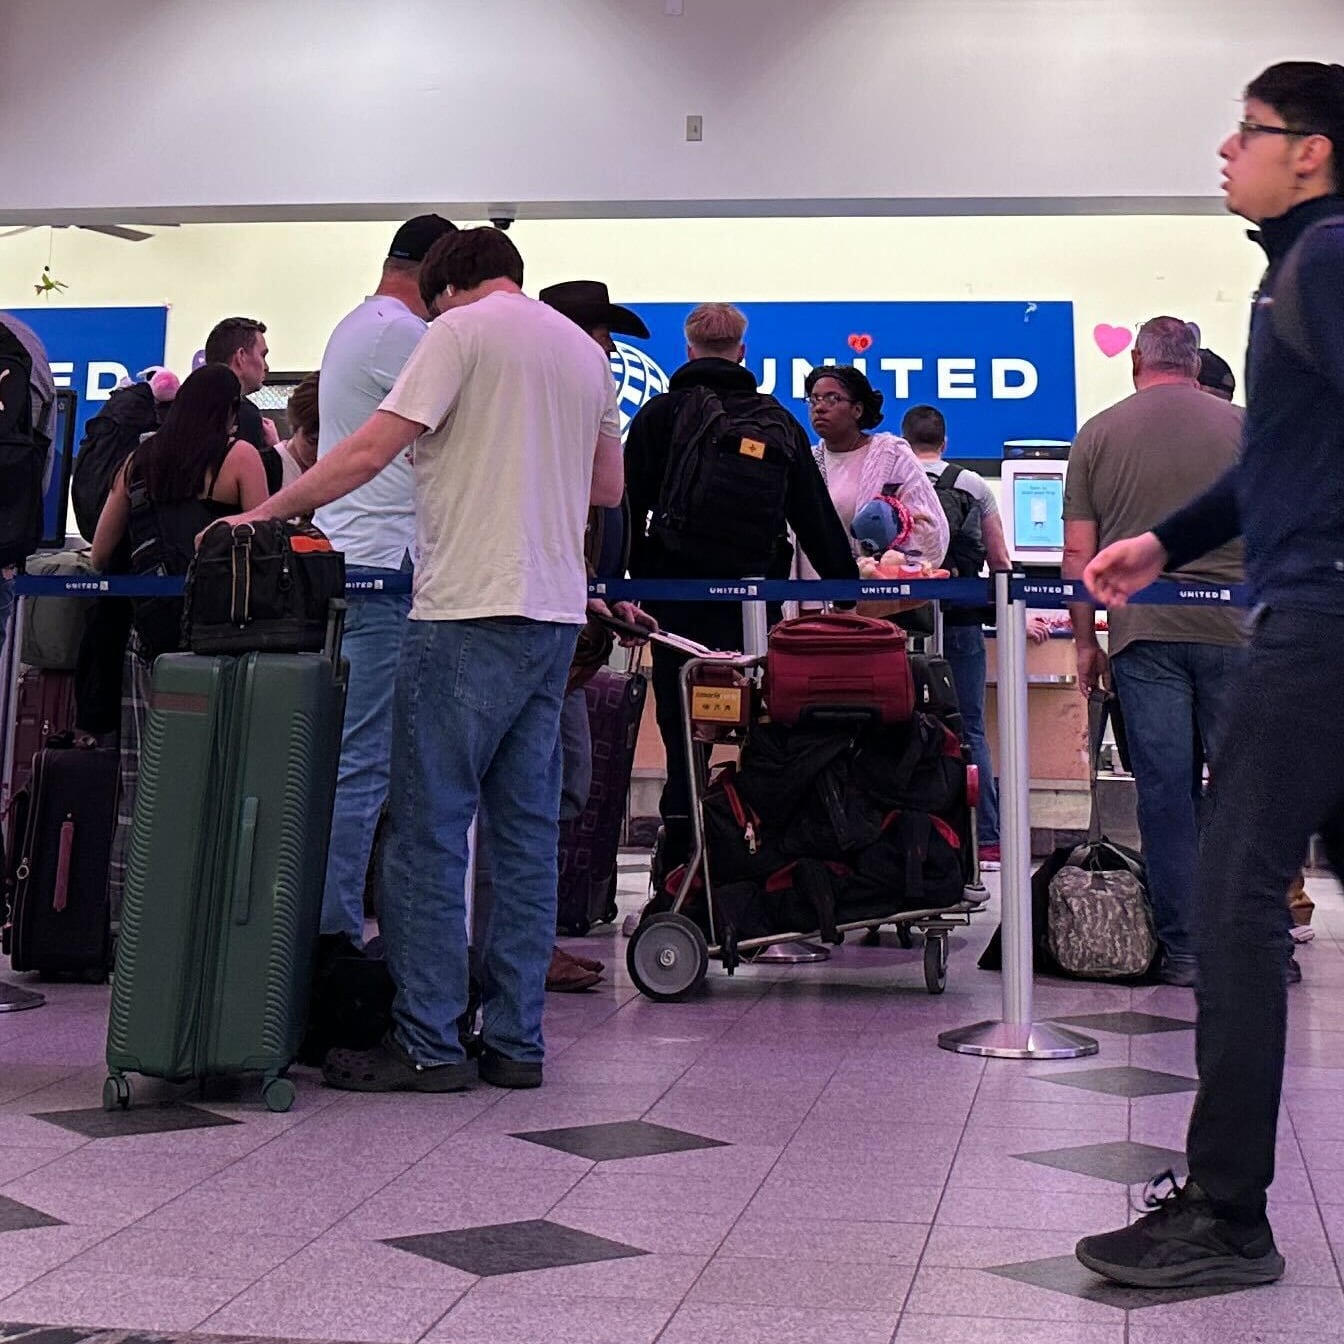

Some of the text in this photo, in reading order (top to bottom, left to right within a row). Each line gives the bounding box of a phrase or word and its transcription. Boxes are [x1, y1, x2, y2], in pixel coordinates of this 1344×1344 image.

[65, 582, 99, 590] UNITED
[345, 581, 374, 590] NITED
[1023, 584, 1062, 594] UNITED
[709, 586, 746, 594] UNITED
[861, 586, 899, 594] UNITED
[1179, 590, 1219, 599] UNITED
